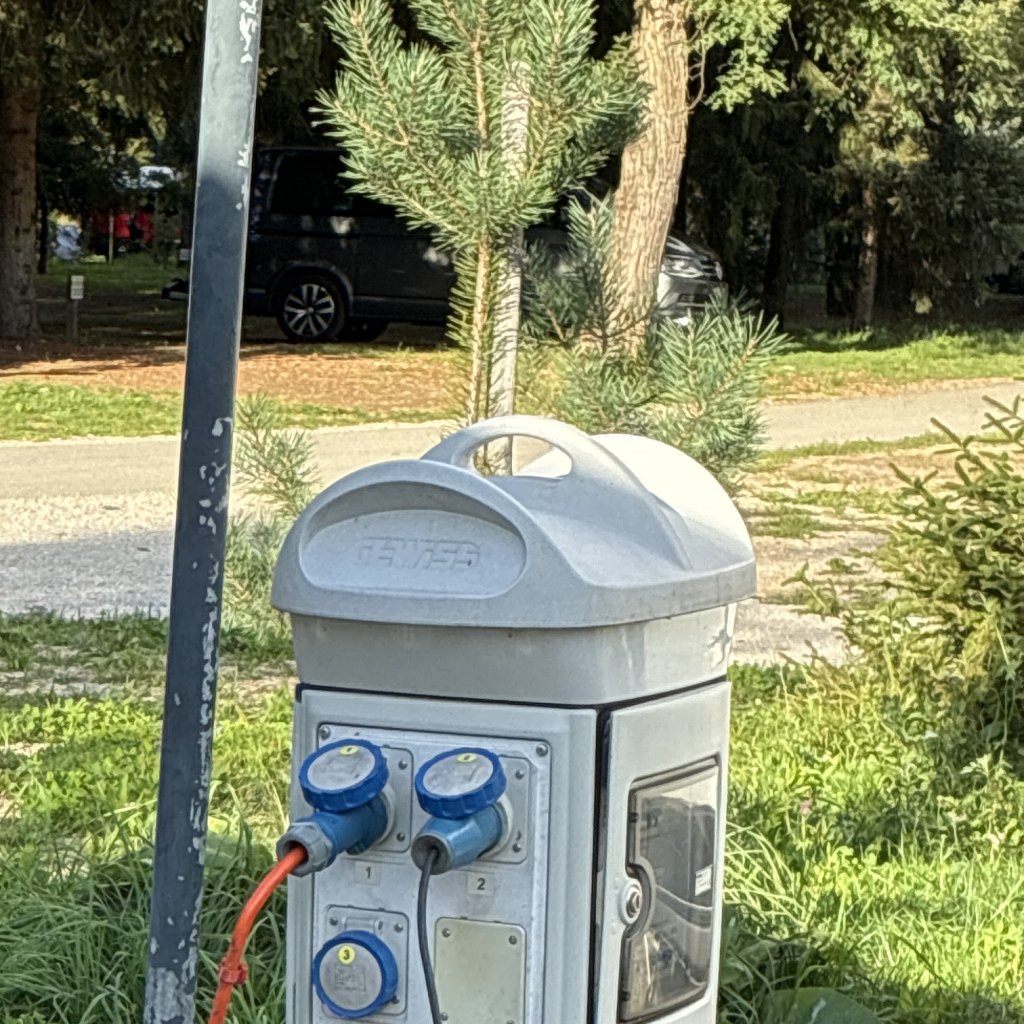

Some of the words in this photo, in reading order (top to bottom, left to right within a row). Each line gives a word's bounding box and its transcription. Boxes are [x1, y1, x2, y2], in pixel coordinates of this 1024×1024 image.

[365, 866, 372, 879] 1
[476, 877, 487, 891] 2
[342, 948, 351, 961] 3
